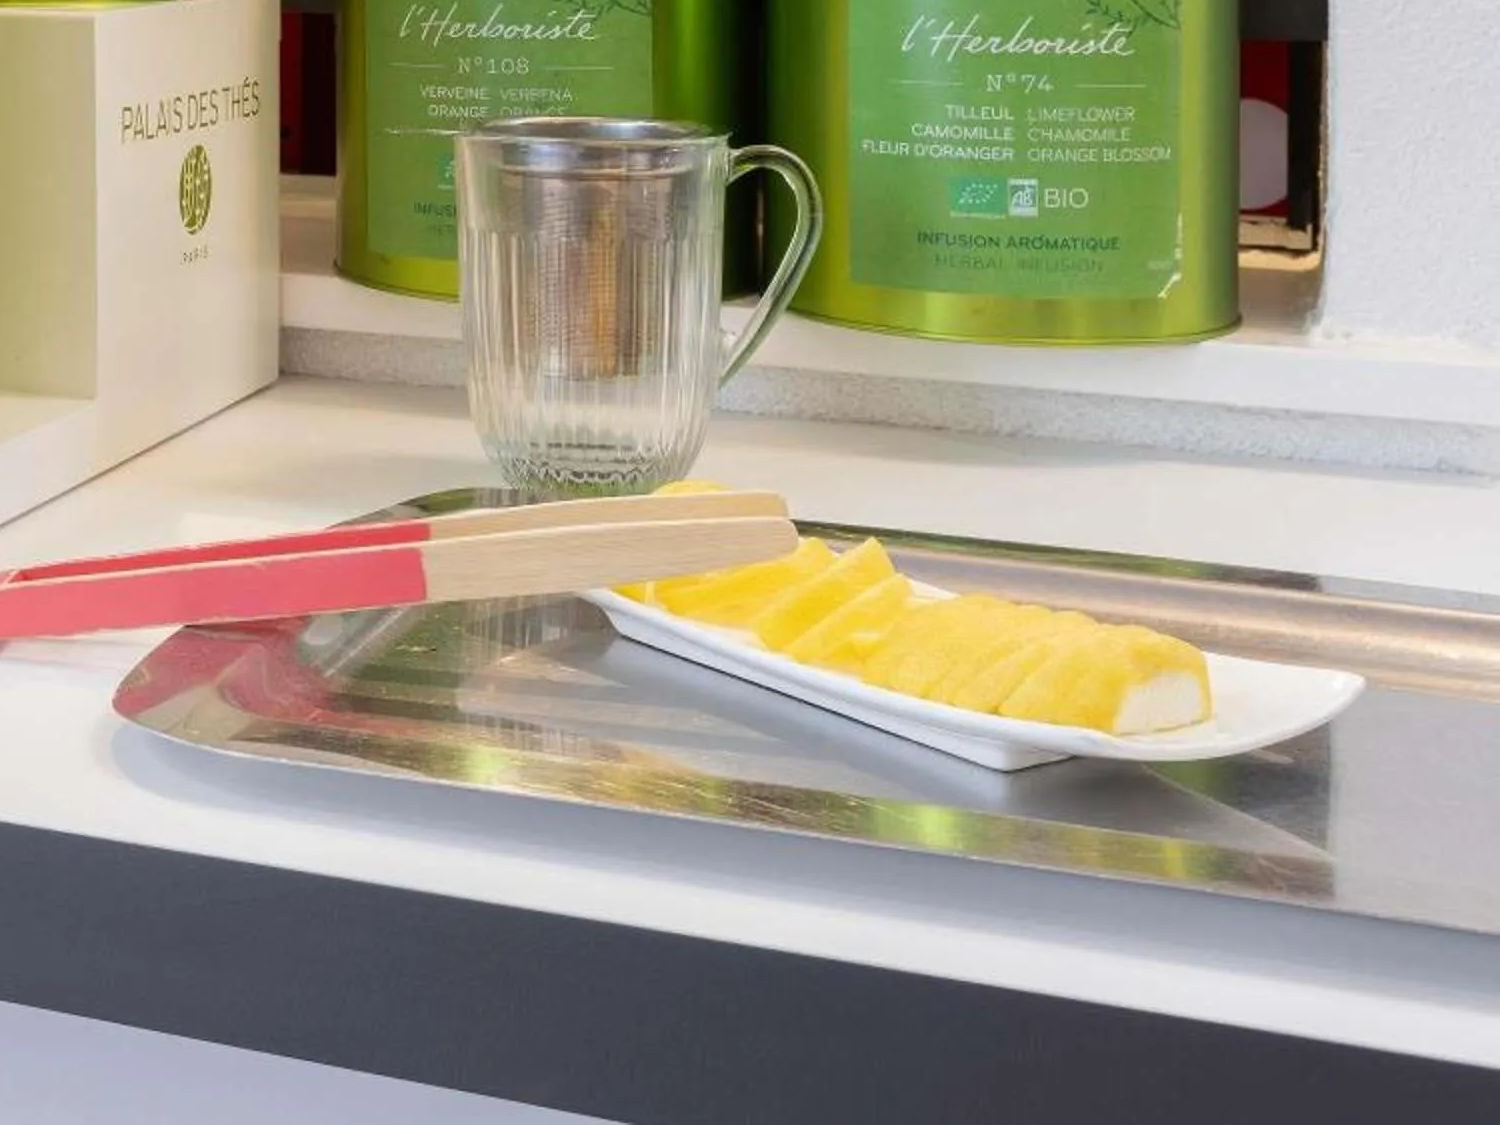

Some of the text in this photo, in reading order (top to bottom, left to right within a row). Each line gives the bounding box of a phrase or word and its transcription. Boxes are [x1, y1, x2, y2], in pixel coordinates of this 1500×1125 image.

[419, 83, 491, 101] VERVEINE
[121, 76, 262, 145] PALAIS DES THÉS
[427, 104, 491, 119] ORANGE
[945, 104, 1015, 121] TILLEUL
[1027, 106, 1136, 123] LIMEFLOWER
[910, 123, 1015, 141] CAMOMILLE
[1027, 127, 1131, 143] CHAMOMILE
[861, 139, 910, 157] FLEUR
[1026, 147, 1098, 163] ORANGE
[1043, 187, 1090, 209] BIO
[916, 231, 1000, 250] INFUSION
